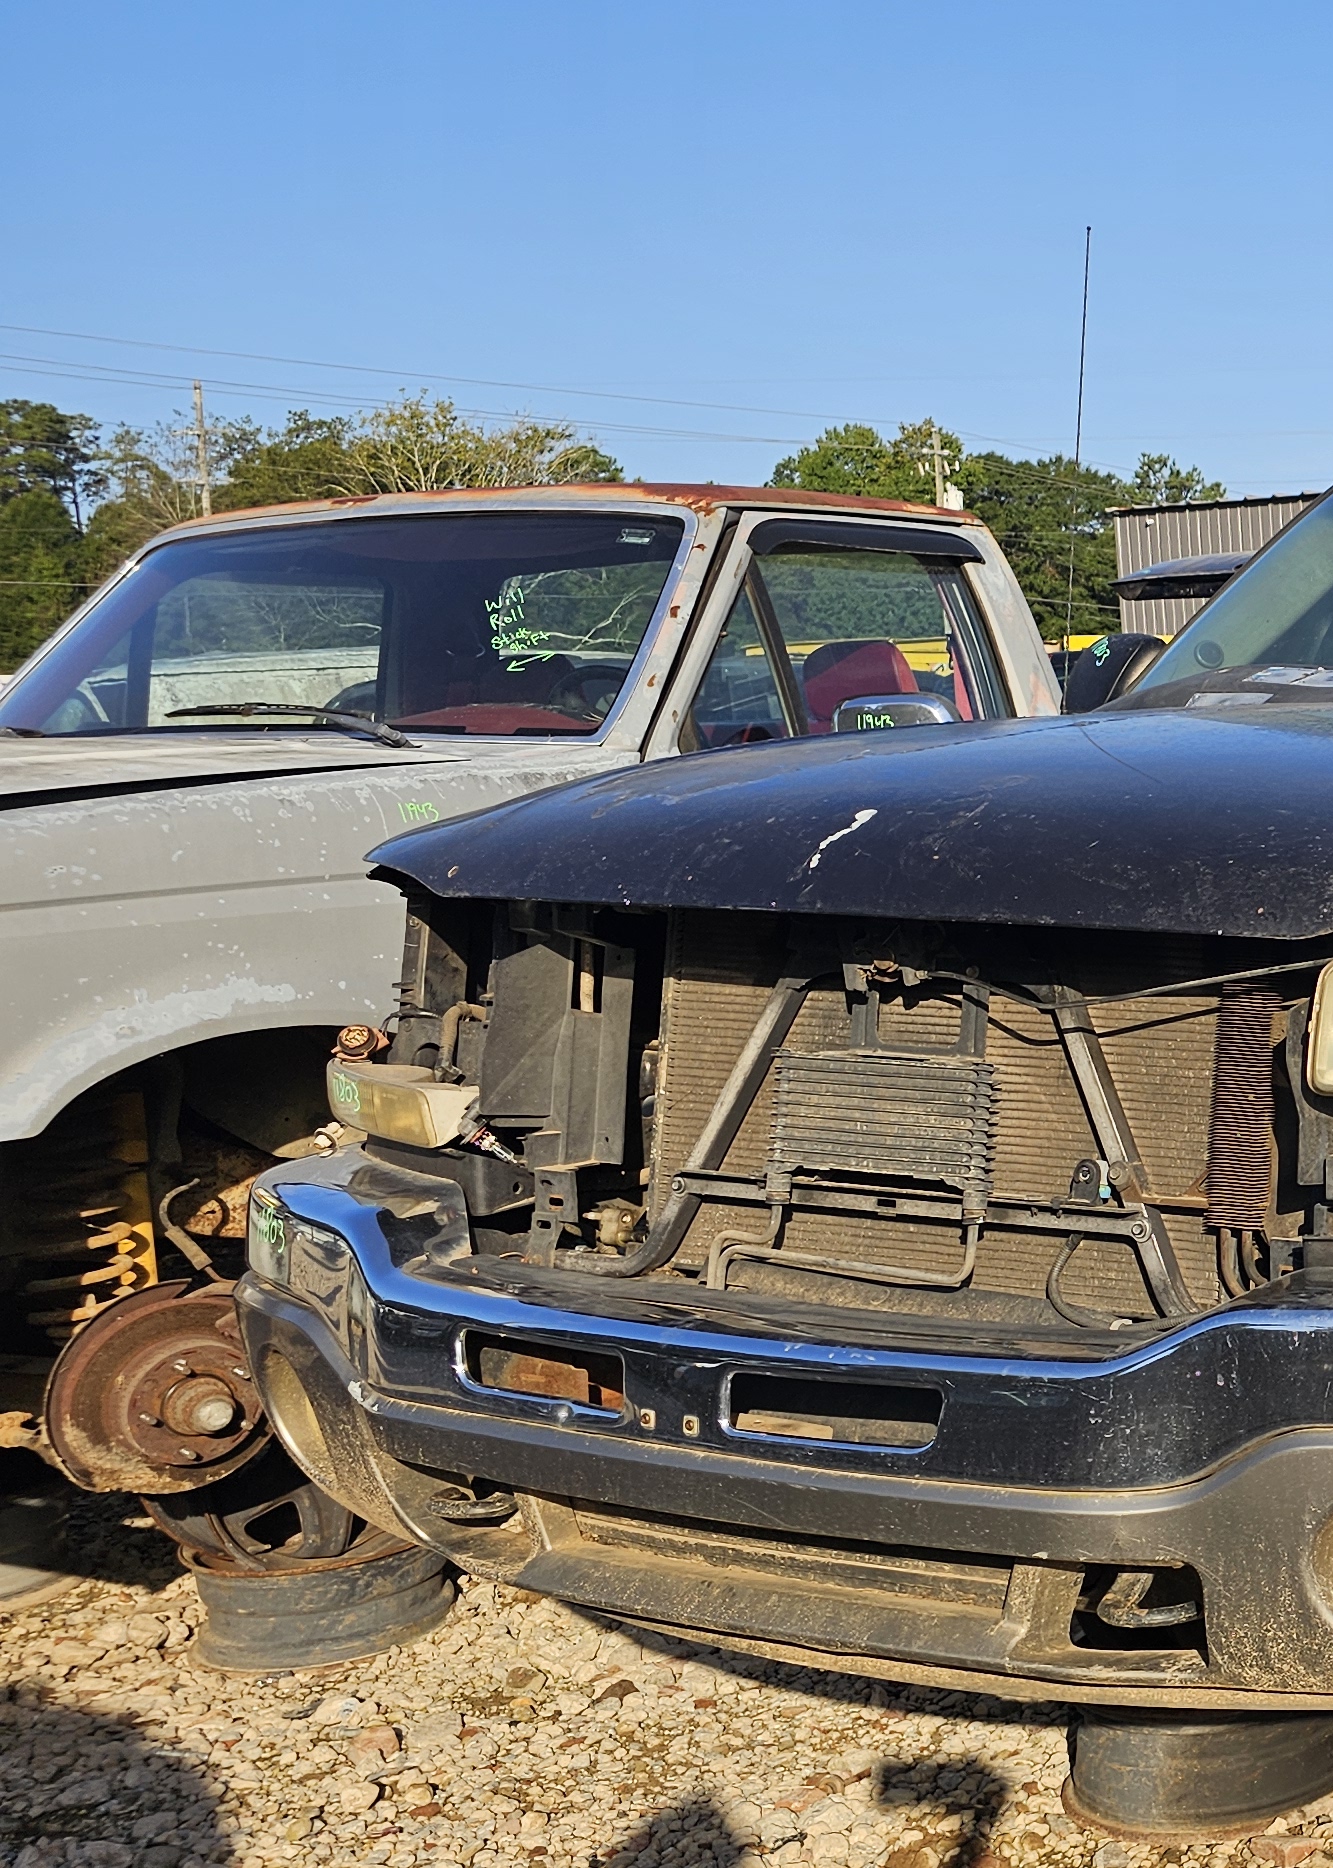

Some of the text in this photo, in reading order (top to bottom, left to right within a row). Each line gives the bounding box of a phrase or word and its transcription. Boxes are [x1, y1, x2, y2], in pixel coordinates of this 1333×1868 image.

[484, 587, 525, 612] Will
[489, 605, 525, 630] Roll
[857, 713, 895, 731] 11943
[397, 801, 439, 823] 11943
